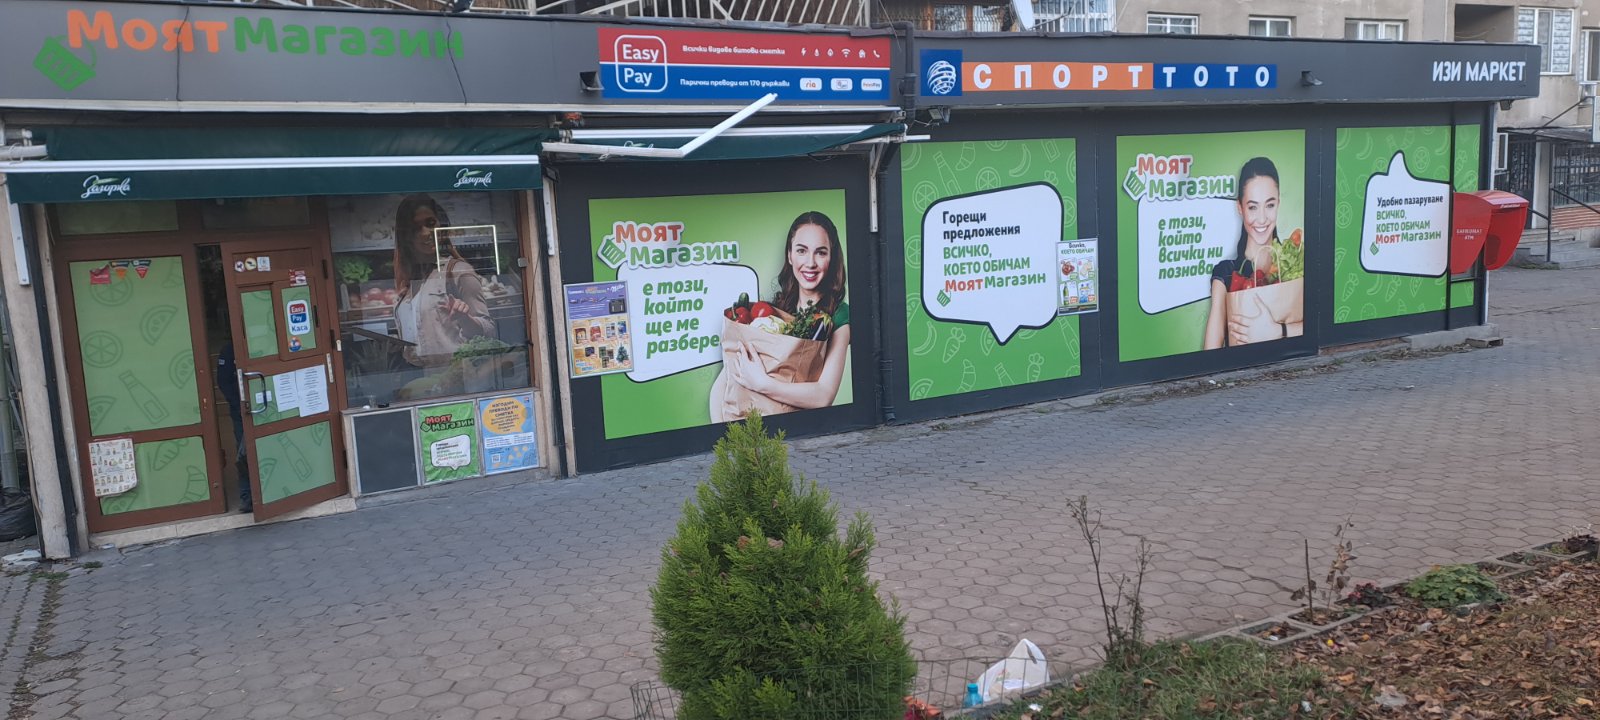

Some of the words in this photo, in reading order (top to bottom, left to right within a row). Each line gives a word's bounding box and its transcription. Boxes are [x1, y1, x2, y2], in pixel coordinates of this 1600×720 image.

[622, 43, 659, 62] Easy
[708, 45, 732, 54] видове
[733, 46, 758, 54] битови
[624, 67, 652, 86] Pay
[973, 64, 1143, 89] СПОРТ
[1162, 65, 1270, 88] ТОТО
[1432, 61, 1461, 82] ИЗИ
[1465, 61, 1526, 82] МАРКЕТ
[1138, 156, 1191, 176] Моят
[1148, 177, 1234, 198] Магазин
[1377, 196, 1403, 208] Удобно
[1404, 195, 1443, 206] пазаруване
[942, 211, 986, 227] Горещи
[1158, 218, 1166, 230] е
[1168, 215, 1206, 230] този,
[1376, 209, 1407, 220] ВСИЧКО,
[615, 223, 682, 243] Моят
[943, 225, 1020, 243] предложения
[1376, 222, 1400, 233] КОЕТО
[1400, 220, 1431, 231] ОБИЧАМ
[1158, 230, 1202, 247] който
[630, 243, 738, 265] Магазин
[943, 244, 992, 260] ВСИЧКО,
[1158, 245, 1204, 263] всички
[1207, 246, 1223, 258] ни
[944, 261, 981, 276] КОЕТО
[983, 257, 1030, 273] ОБИЧАМ
[642, 282, 654, 296] е
[656, 279, 708, 296] този,
[291, 305, 304, 313] Easy
[644, 296, 704, 316] който
[645, 319, 674, 336] ще
[676, 318, 700, 331] ме
[425, 414, 452, 424] Моят
[431, 419, 474, 431] Магазин
